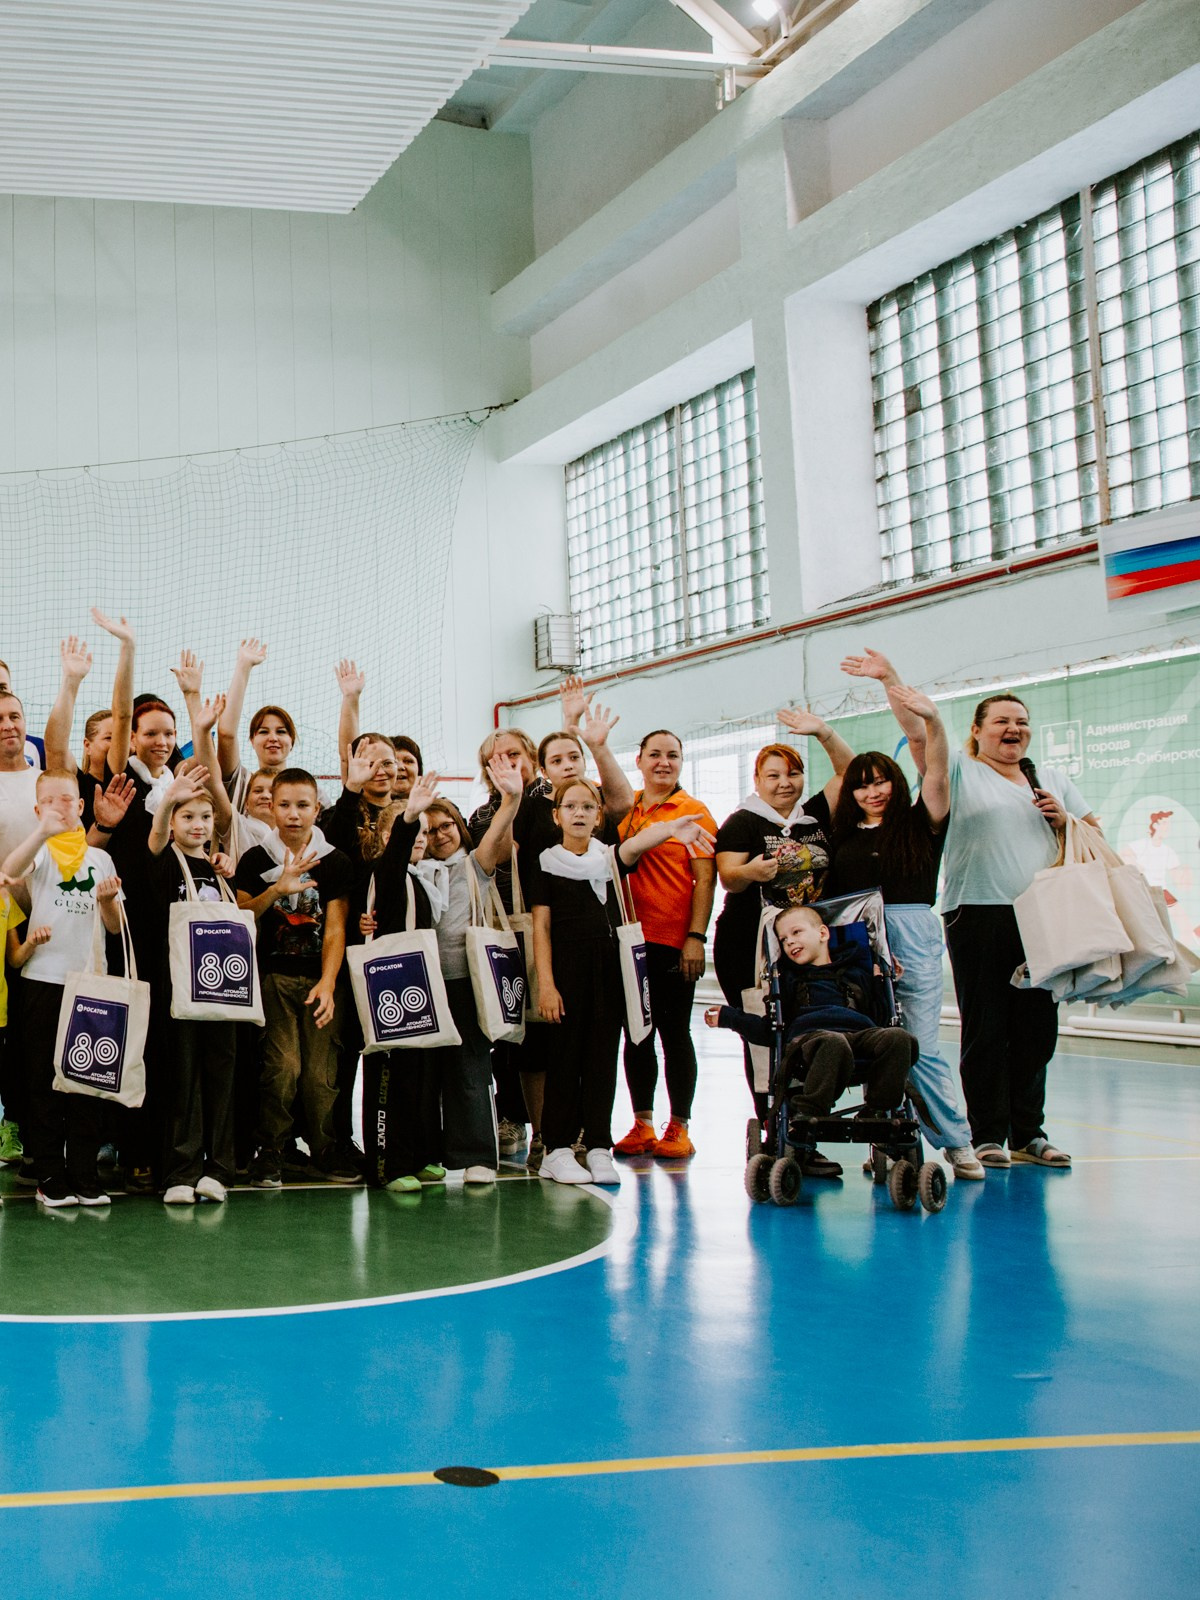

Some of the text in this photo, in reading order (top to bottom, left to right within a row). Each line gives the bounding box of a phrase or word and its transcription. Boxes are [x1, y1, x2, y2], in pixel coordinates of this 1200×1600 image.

[1086, 713, 1188, 737] Администрация
[1086, 739, 1131, 754] города
[54, 898, 94, 911] GUSSI
[197, 952, 248, 989] 80
[376, 963, 403, 972] РОСАТОМ
[83, 1006, 108, 1016] РОСАТОМ
[377, 986, 427, 1027] 80
[68, 1032, 119, 1072] 80
[377, 1110, 386, 1150] JOMOTO
